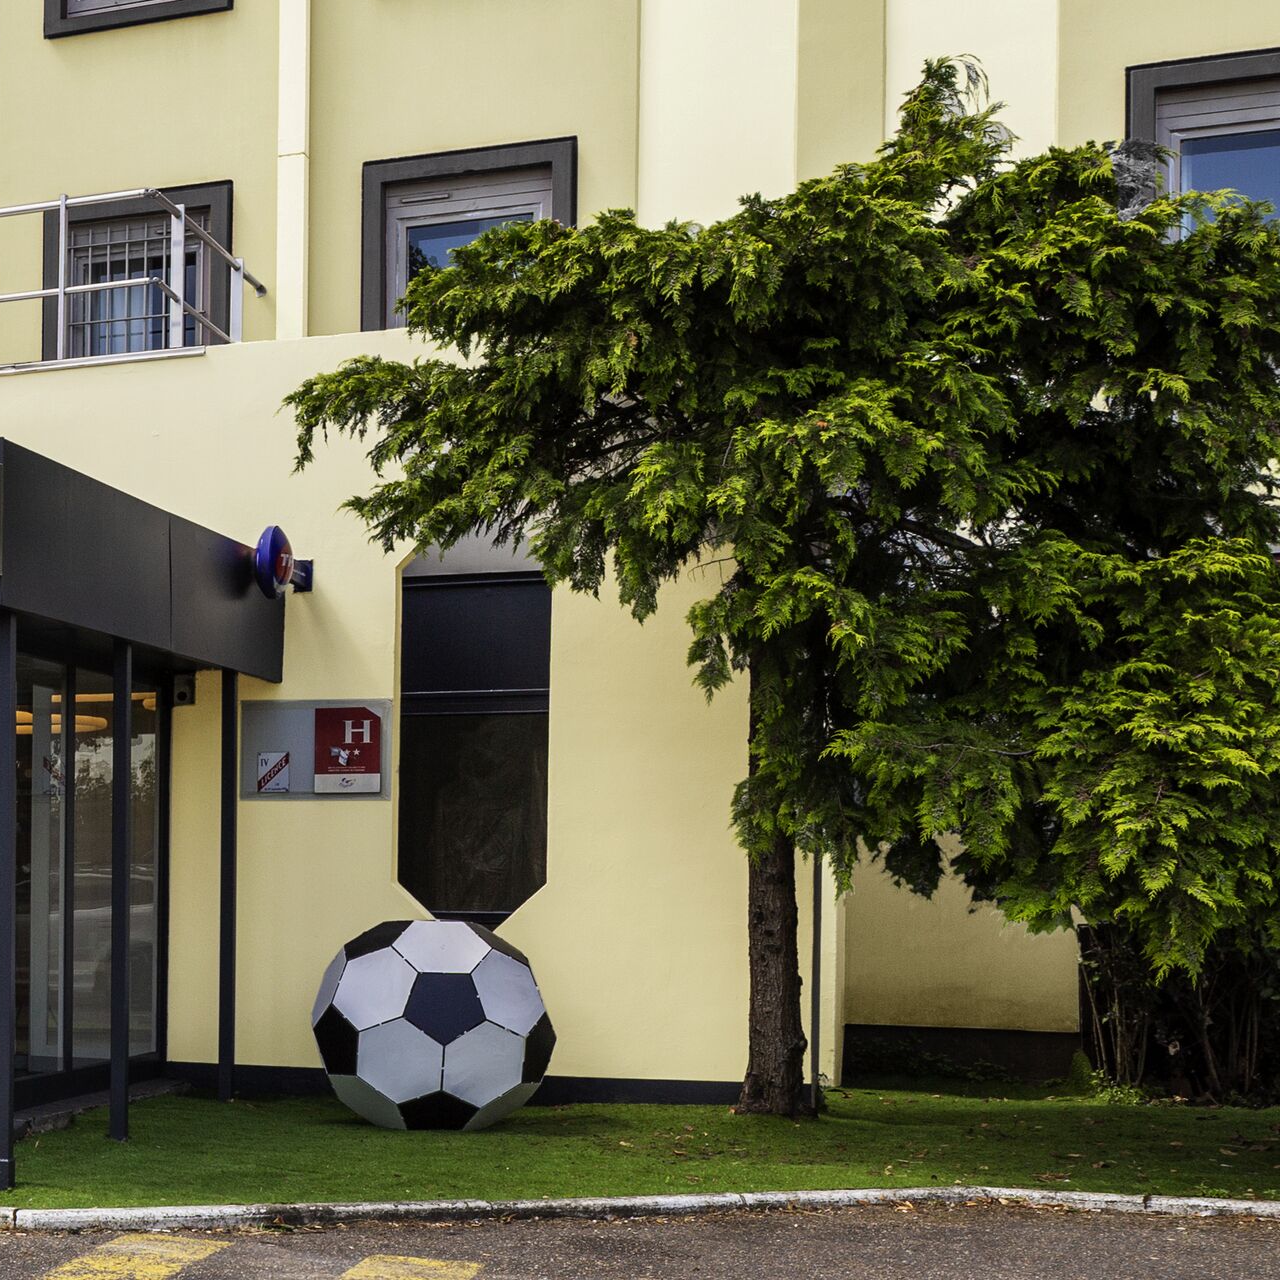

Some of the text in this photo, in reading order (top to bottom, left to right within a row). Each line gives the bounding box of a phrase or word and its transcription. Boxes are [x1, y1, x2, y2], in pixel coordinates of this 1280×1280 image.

[343, 719, 374, 744] H
[260, 758, 270, 767] IV
[261, 756, 287, 786] LICENCE
